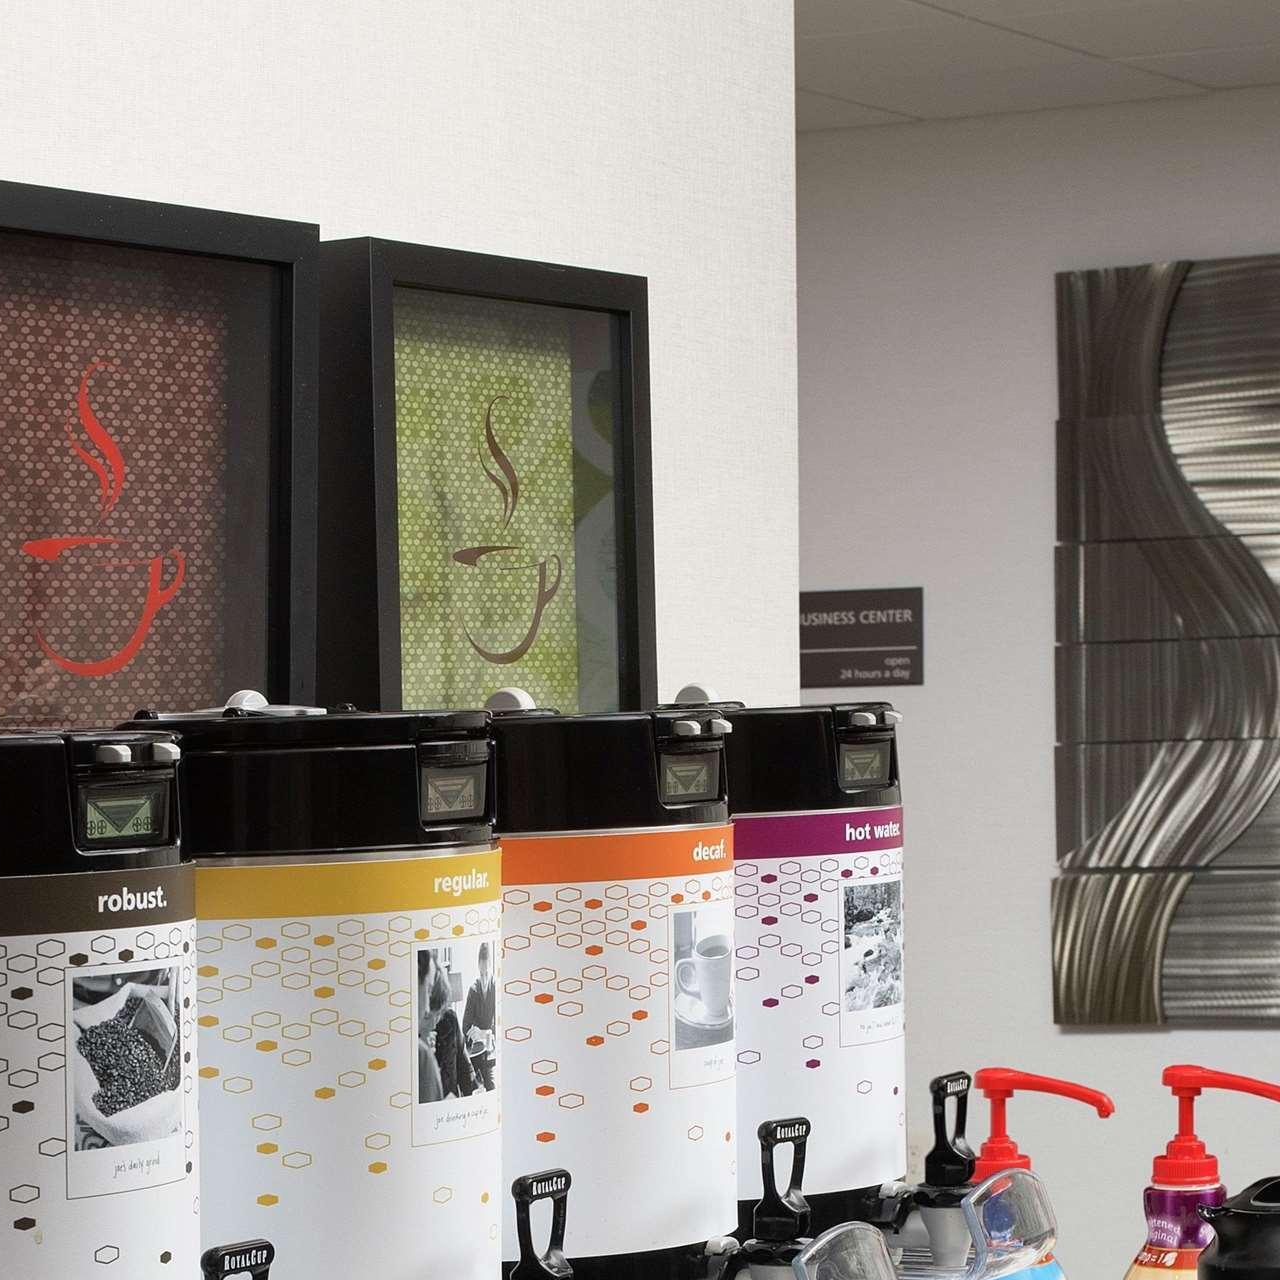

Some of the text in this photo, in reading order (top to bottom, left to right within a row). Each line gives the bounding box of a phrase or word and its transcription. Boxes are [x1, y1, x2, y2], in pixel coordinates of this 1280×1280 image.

[800, 609, 913, 626] USINESS CENTER
[884, 657, 911, 668] open
[839, 669, 853, 679] 24
[854, 669, 882, 679] hours
[892, 668, 911, 680] day
[845, 823, 872, 842] hot
[692, 838, 727, 862] decaf.
[433, 867, 490, 897] regular.
[97, 885, 168, 913] robust.
